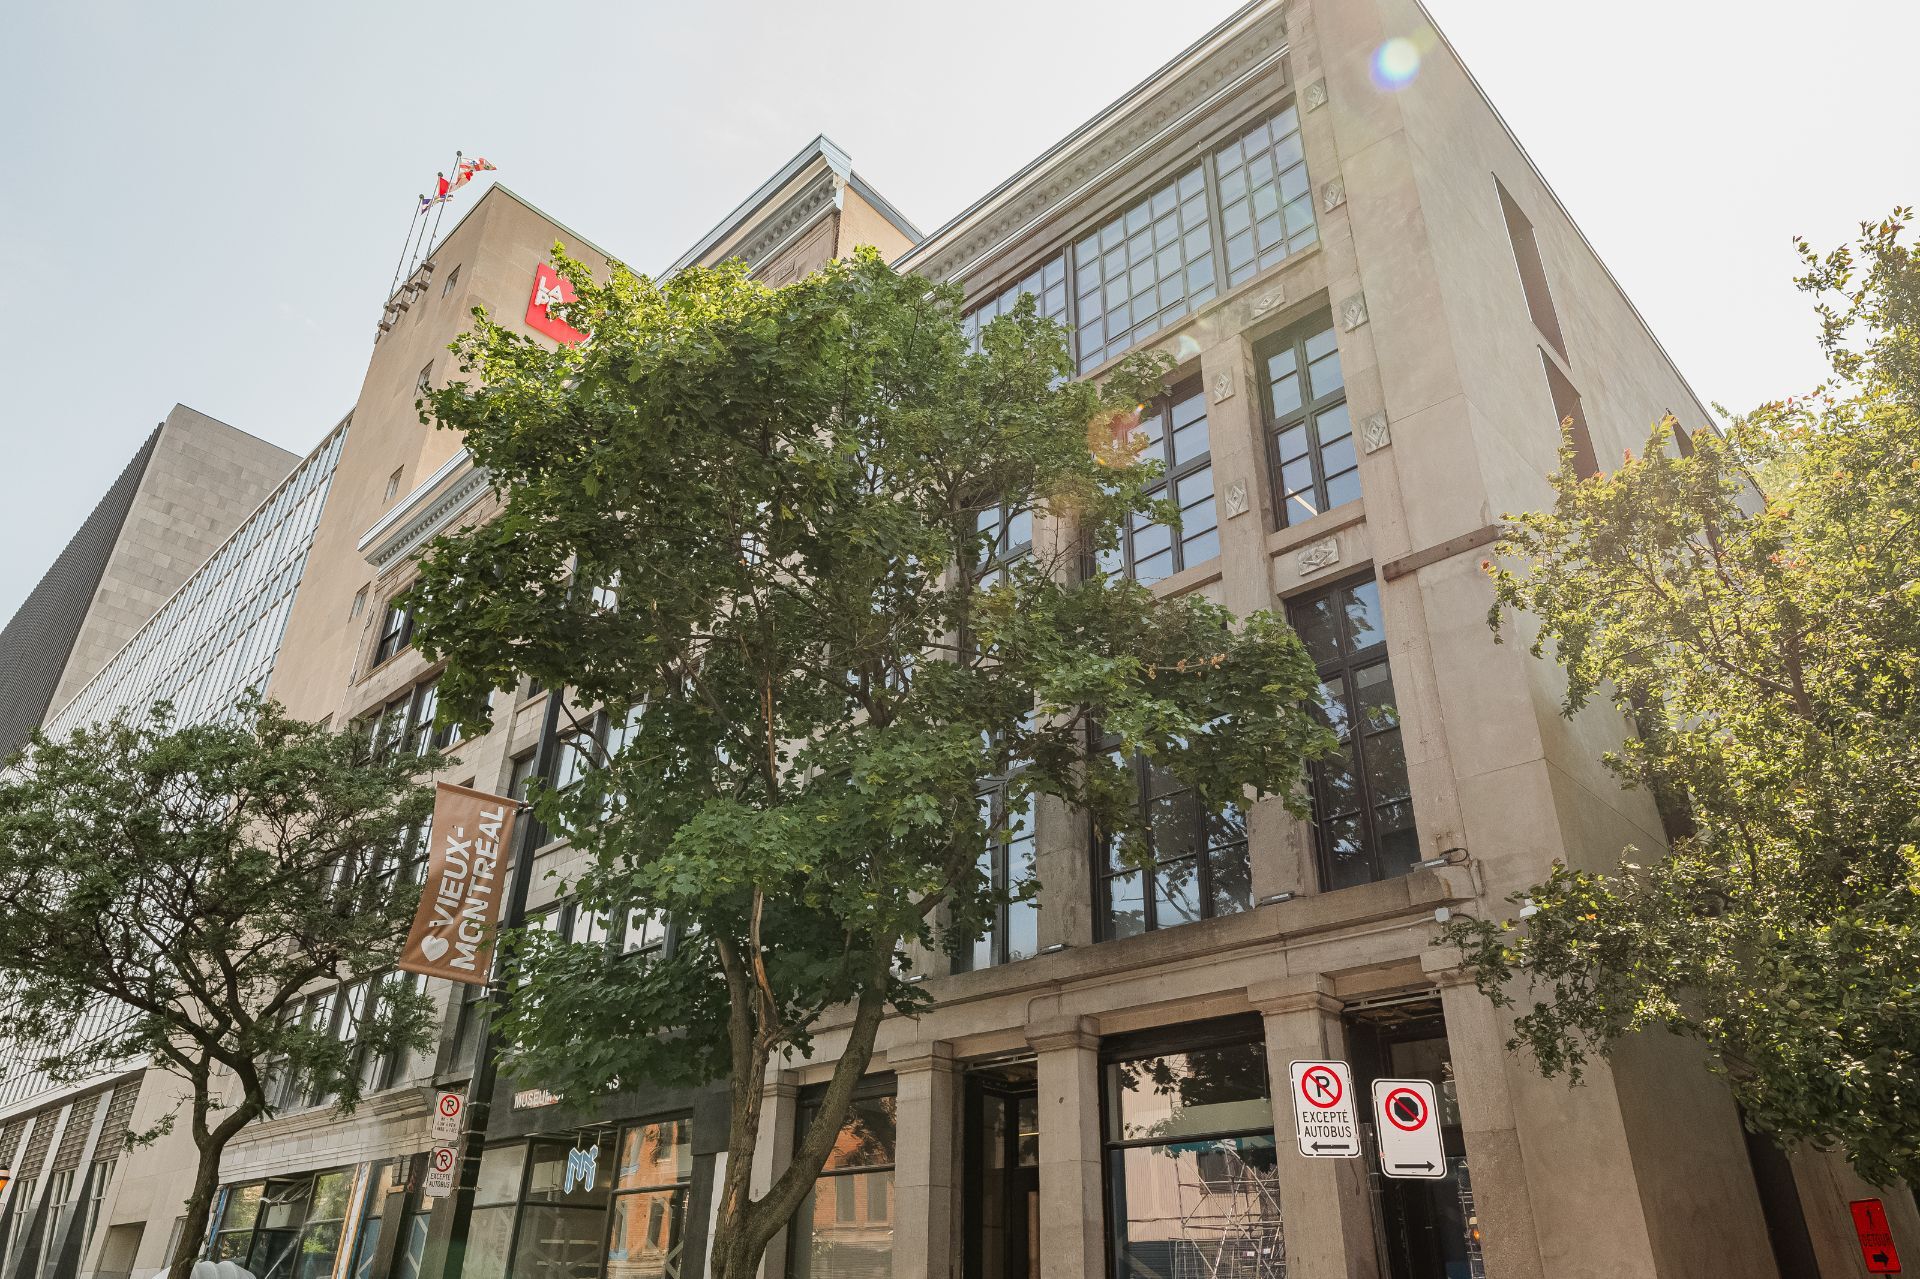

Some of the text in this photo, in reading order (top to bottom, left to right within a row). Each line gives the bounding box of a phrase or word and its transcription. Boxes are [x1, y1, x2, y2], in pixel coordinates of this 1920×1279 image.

[429, 827, 471, 927] VIEUX-
[450, 806, 504, 970] MONTRÉAL
[1303, 1109, 1349, 1123] EXCEPTÉ
[1304, 1125, 1352, 1138] AUTOBUS
